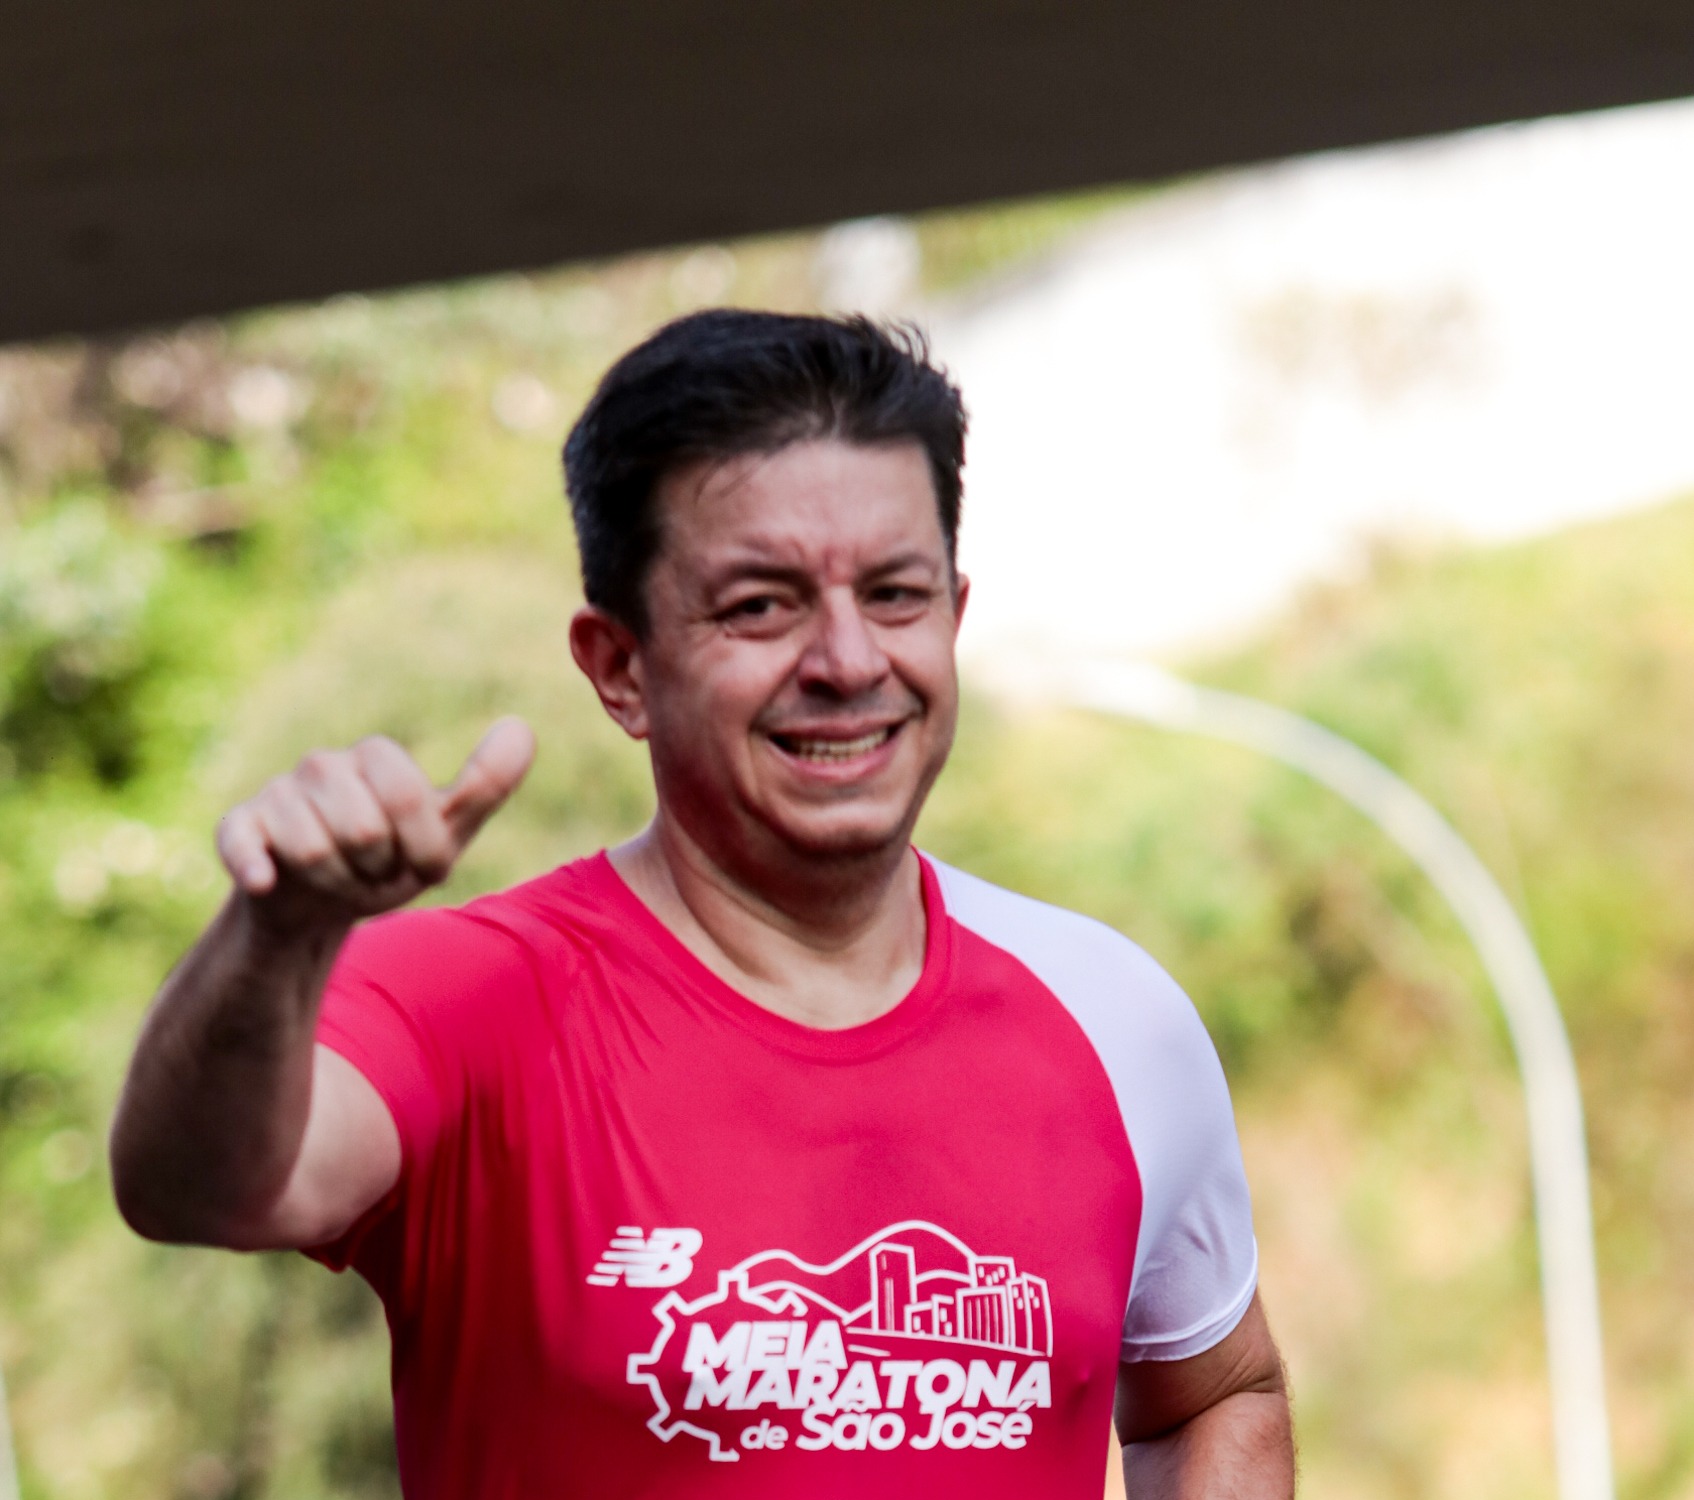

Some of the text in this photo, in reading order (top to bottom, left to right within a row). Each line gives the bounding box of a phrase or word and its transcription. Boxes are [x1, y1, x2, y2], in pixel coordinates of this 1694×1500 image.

[682, 1320, 848, 1373] MEIA
[684, 1358, 1052, 1410] MARATONA
[740, 1403, 1034, 1451] de São José
